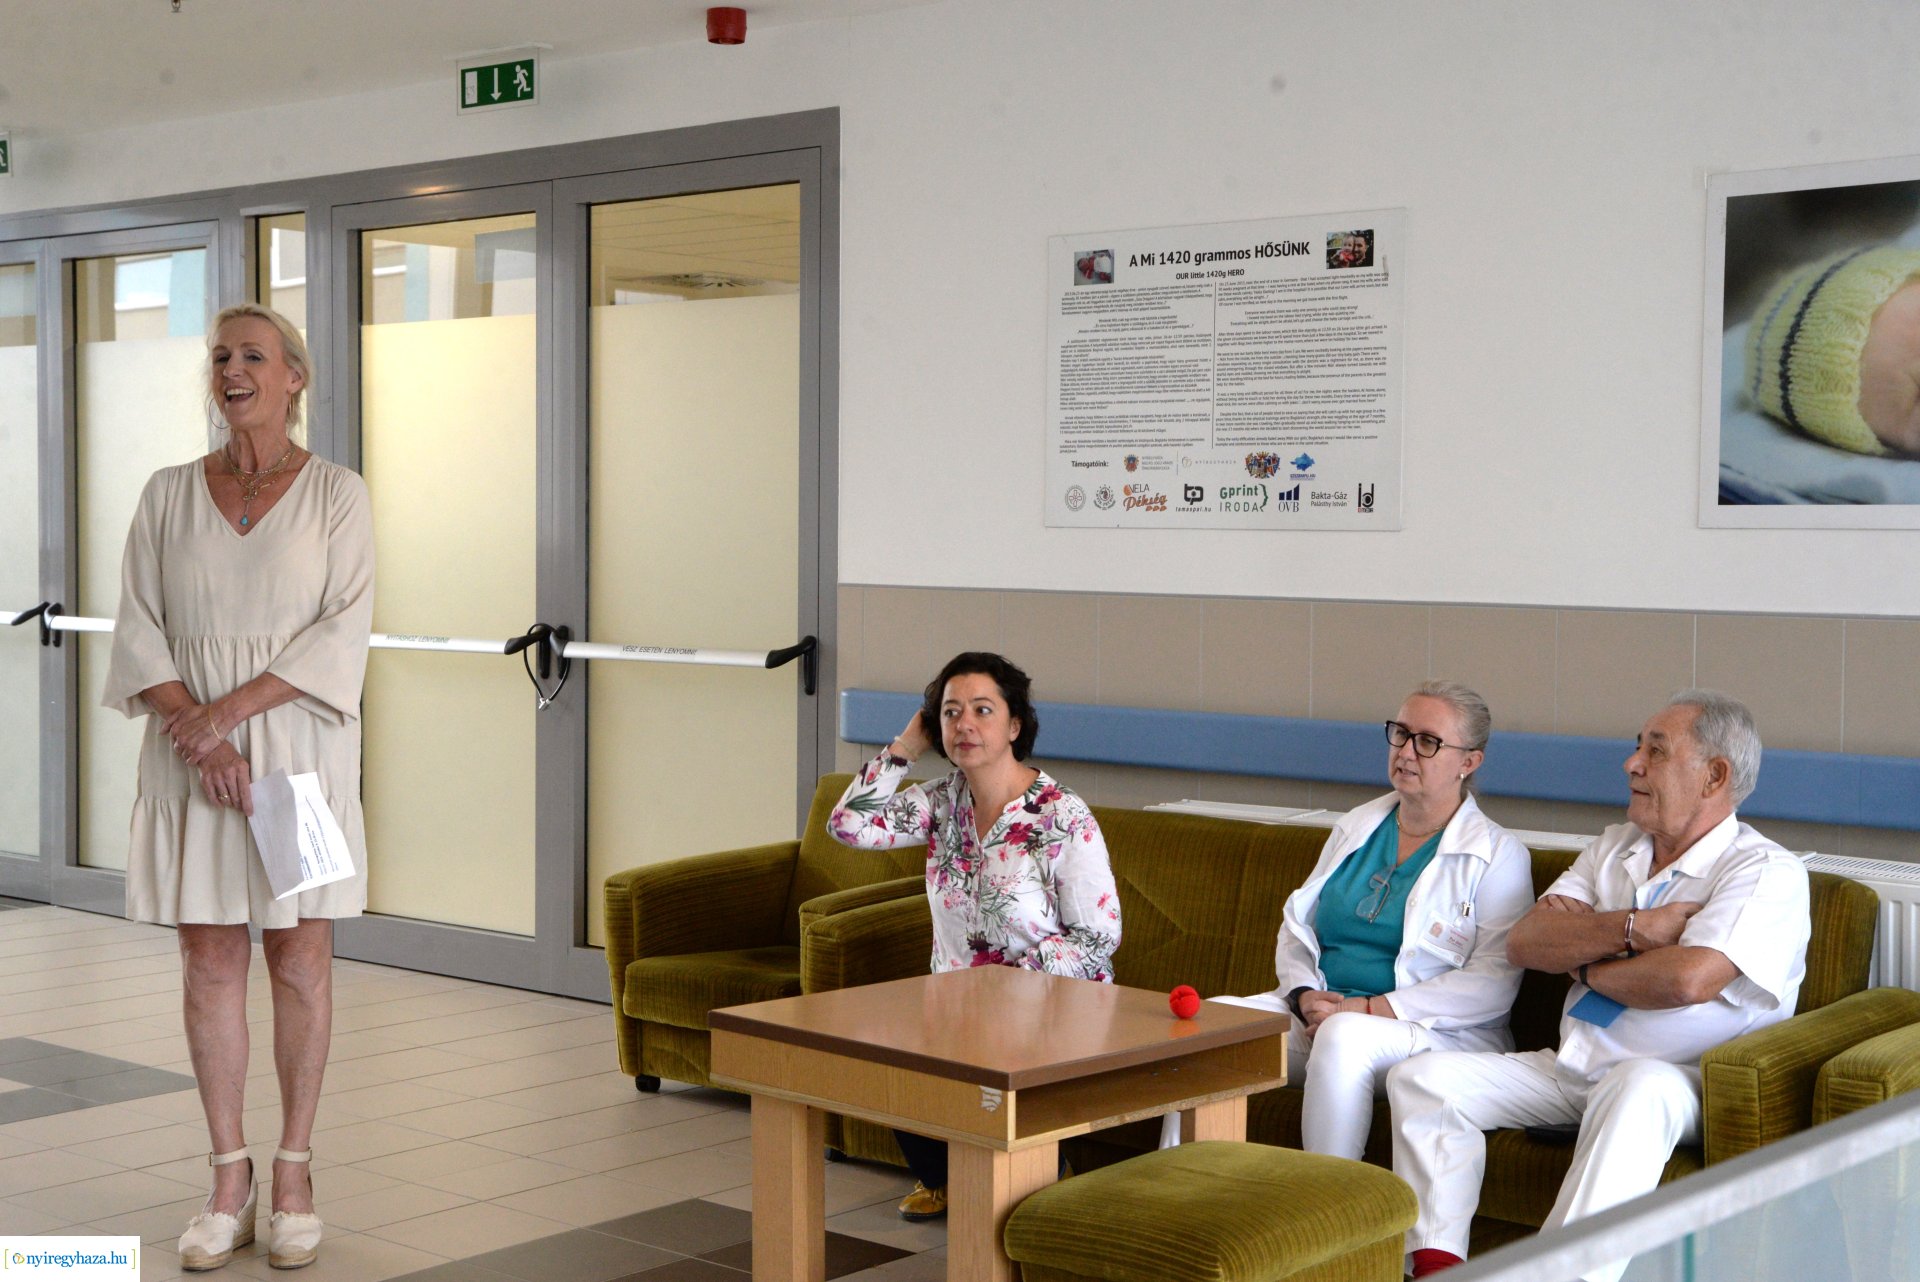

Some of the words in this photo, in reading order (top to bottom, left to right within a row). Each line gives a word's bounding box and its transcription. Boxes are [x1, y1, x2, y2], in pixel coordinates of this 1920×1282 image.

[1129, 254, 1138, 267] A
[1140, 252, 1155, 267] Mi
[1159, 250, 1190, 265] 1420
[1194, 249, 1251, 265] grammos
[1254, 241, 1311, 259] HŐSÜNK
[1176, 272, 1189, 280] OUR
[1190, 270, 1205, 279] little
[1206, 270, 1226, 279] 1420g
[1227, 268, 1245, 277] HERO
[1071, 460, 1109, 469] Támogatóink:
[1219, 484, 1259, 499] Gprint
[1310, 491, 1348, 500] Bakta-Gáz
[1122, 492, 1168, 512] Pékség
[1219, 502, 1259, 512] IRODA
[1278, 502, 1300, 513] OVB
